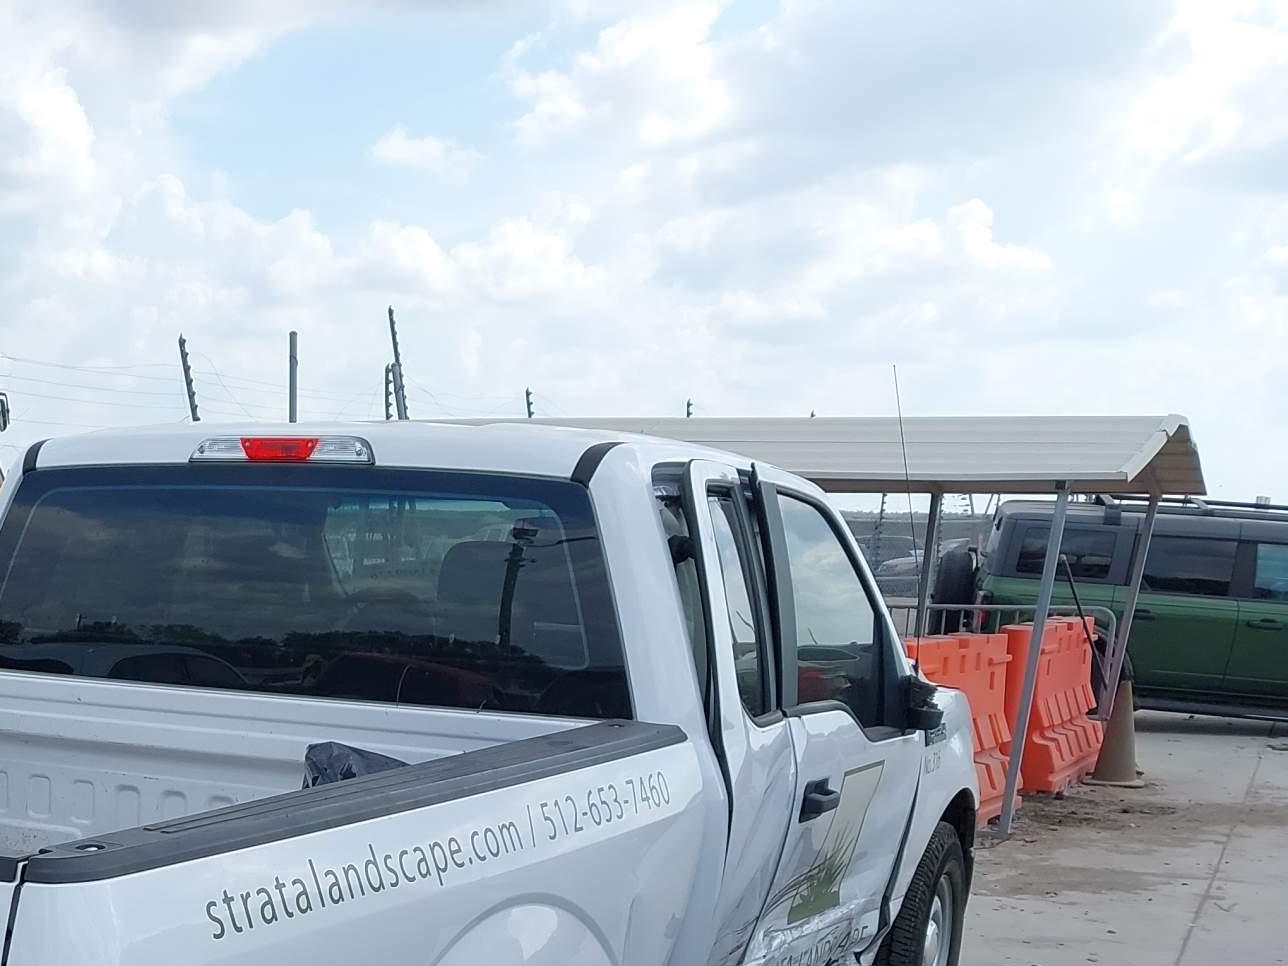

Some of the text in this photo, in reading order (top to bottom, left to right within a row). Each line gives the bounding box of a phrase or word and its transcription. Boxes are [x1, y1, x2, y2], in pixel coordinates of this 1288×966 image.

[205, 769, 671, 940] stratalandscape.com / 512-653-7460
